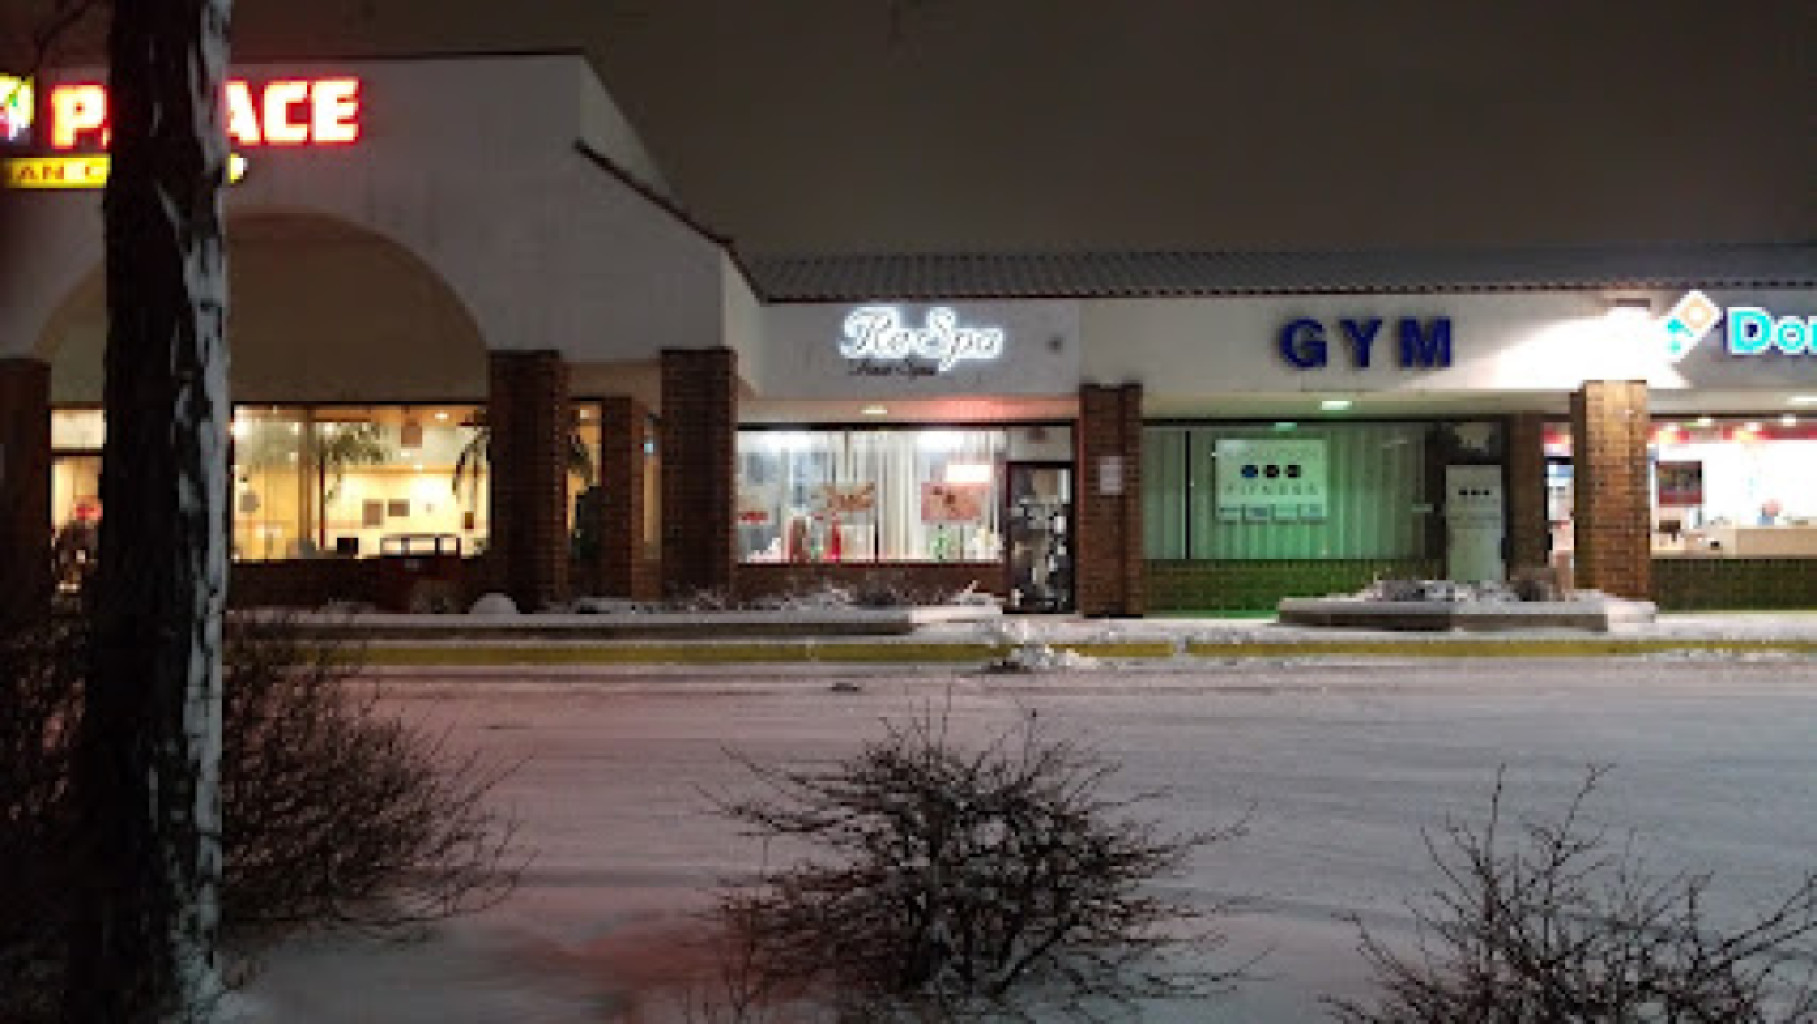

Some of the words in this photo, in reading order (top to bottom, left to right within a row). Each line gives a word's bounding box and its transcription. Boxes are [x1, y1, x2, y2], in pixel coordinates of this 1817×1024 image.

[50, 79, 361, 149] PACE
[1278, 315, 1453, 369] GYM
[1728, 306, 1817, 355] Do
